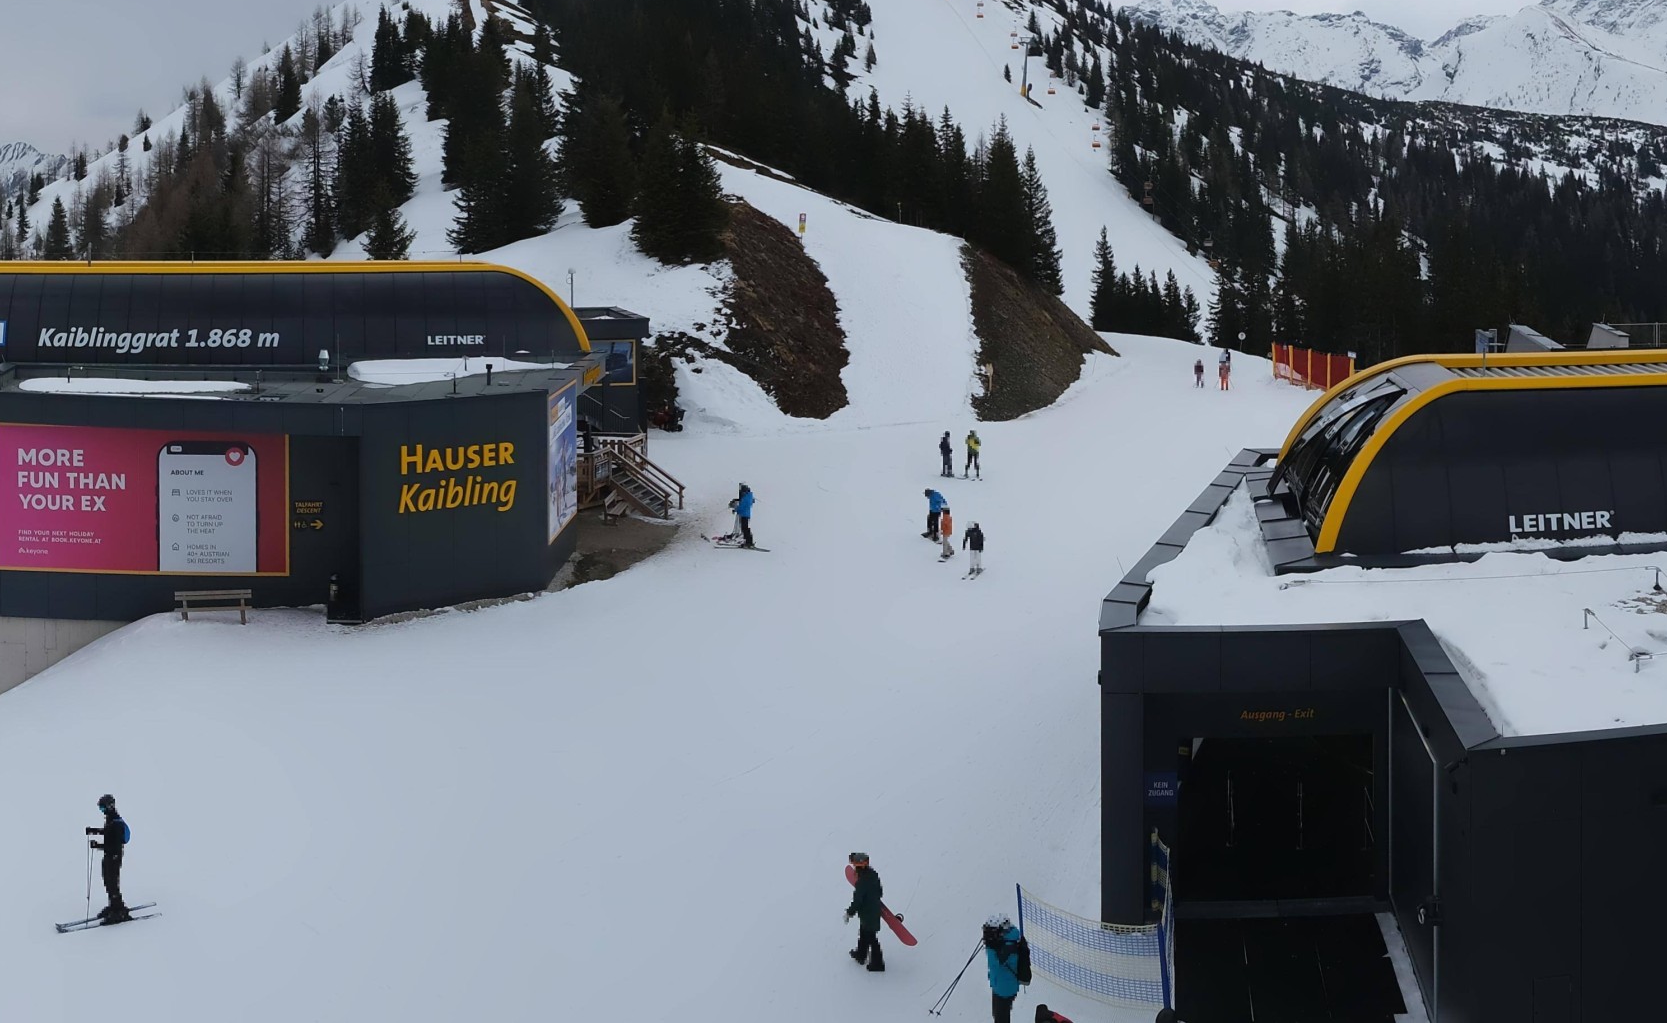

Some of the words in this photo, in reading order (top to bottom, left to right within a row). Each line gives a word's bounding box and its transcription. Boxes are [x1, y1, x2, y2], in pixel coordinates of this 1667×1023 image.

[38, 327, 179, 354] Kaiblinggrat
[185, 329, 252, 347] 1.868
[257, 332, 280, 348] m
[427, 335, 485, 345] LEITNER
[18, 448, 84, 467] MORE
[400, 442, 515, 475] HAUSER
[18, 471, 59, 488] FUN
[66, 472, 126, 490] THAN
[19, 494, 75, 510] YOUR
[81, 495, 106, 511] EX
[398, 476, 517, 514] Kaibling
[1509, 510, 1613, 533] LEITNER
[1240, 710, 1285, 721] Ausgang
[1294, 708, 1315, 719] Exit
[1148, 789, 1173, 797] ZUGANG
[1153, 781, 1168, 789] KEIN
